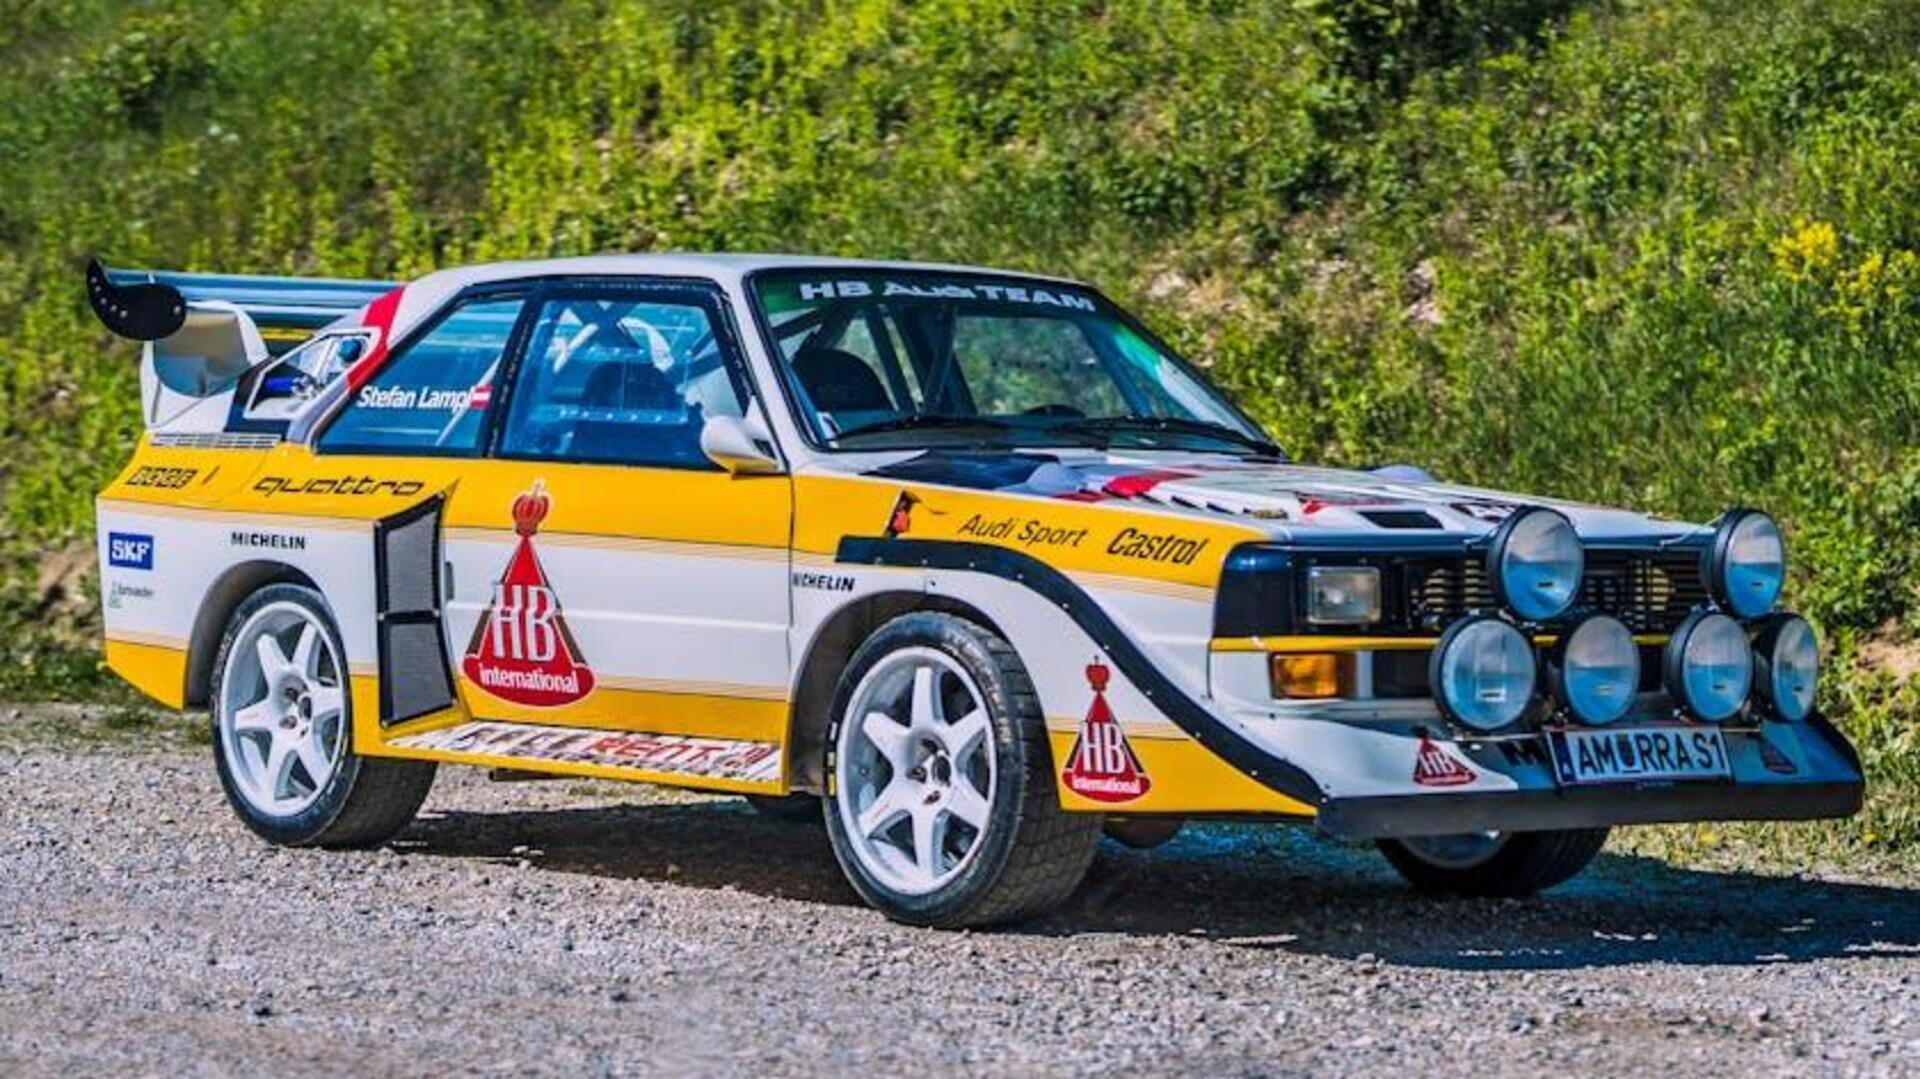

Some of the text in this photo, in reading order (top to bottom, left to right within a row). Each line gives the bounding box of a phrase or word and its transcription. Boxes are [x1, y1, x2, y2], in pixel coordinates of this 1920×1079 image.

[801, 281, 873, 300] HB
[975, 285, 1096, 312] TEAM
[357, 385, 416, 408] Stefan
[253, 475, 425, 497] quattro
[231, 532, 306, 550] MICHELIN
[957, 513, 1088, 547] Audi Sport
[1106, 527, 1208, 566] Castrol
[111, 539, 151, 563] SKF
[492, 584, 557, 662] HB
[478, 662, 580, 695] international
[1081, 722, 1126, 773] HB
[1577, 733, 1621, 776] AM
